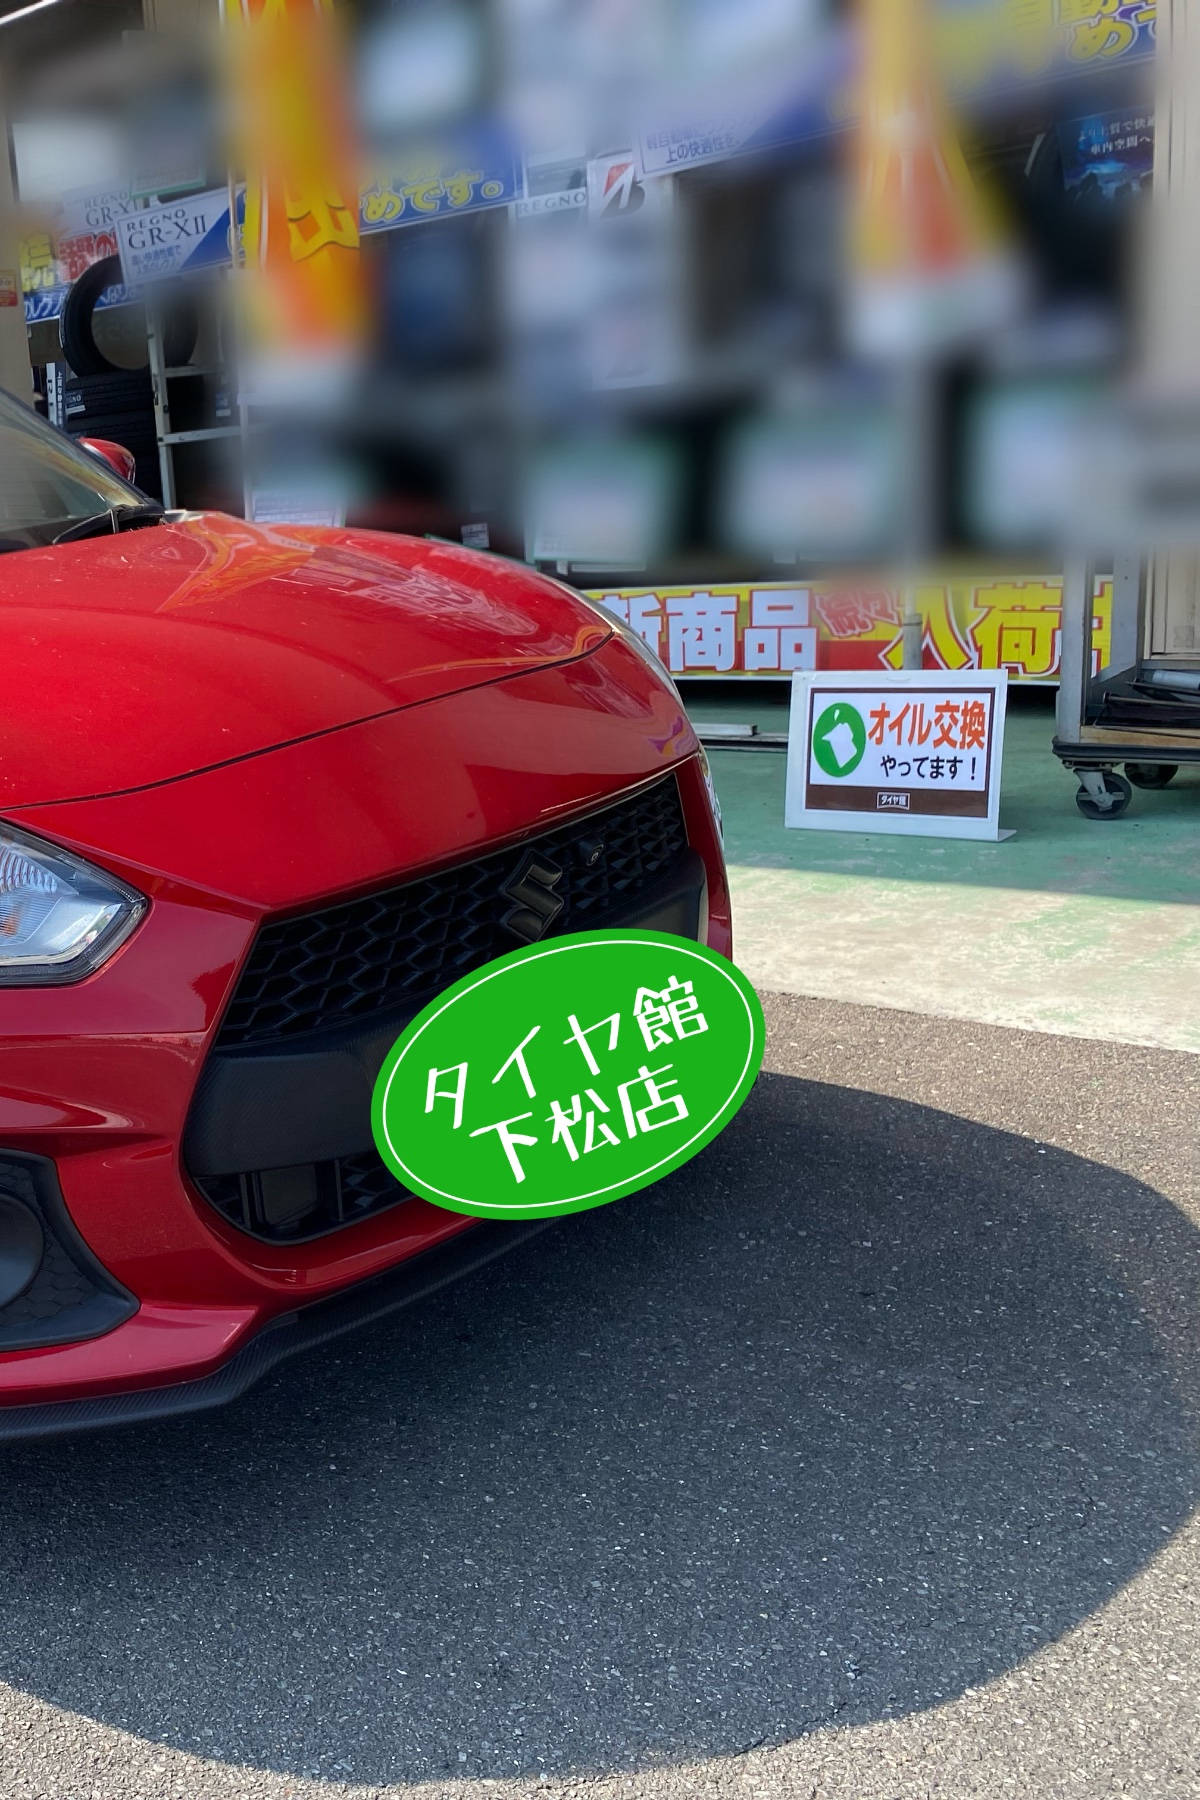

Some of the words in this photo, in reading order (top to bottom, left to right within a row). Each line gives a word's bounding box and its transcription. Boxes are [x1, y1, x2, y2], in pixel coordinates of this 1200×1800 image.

[517, 191, 586, 215] REGNO
[126, 208, 186, 232] REGNO
[128, 214, 206, 250] GR-XII
[598, 588, 818, 672] 新商品
[868, 700, 986, 750] オイル交換
[880, 754, 977, 781] やってます！
